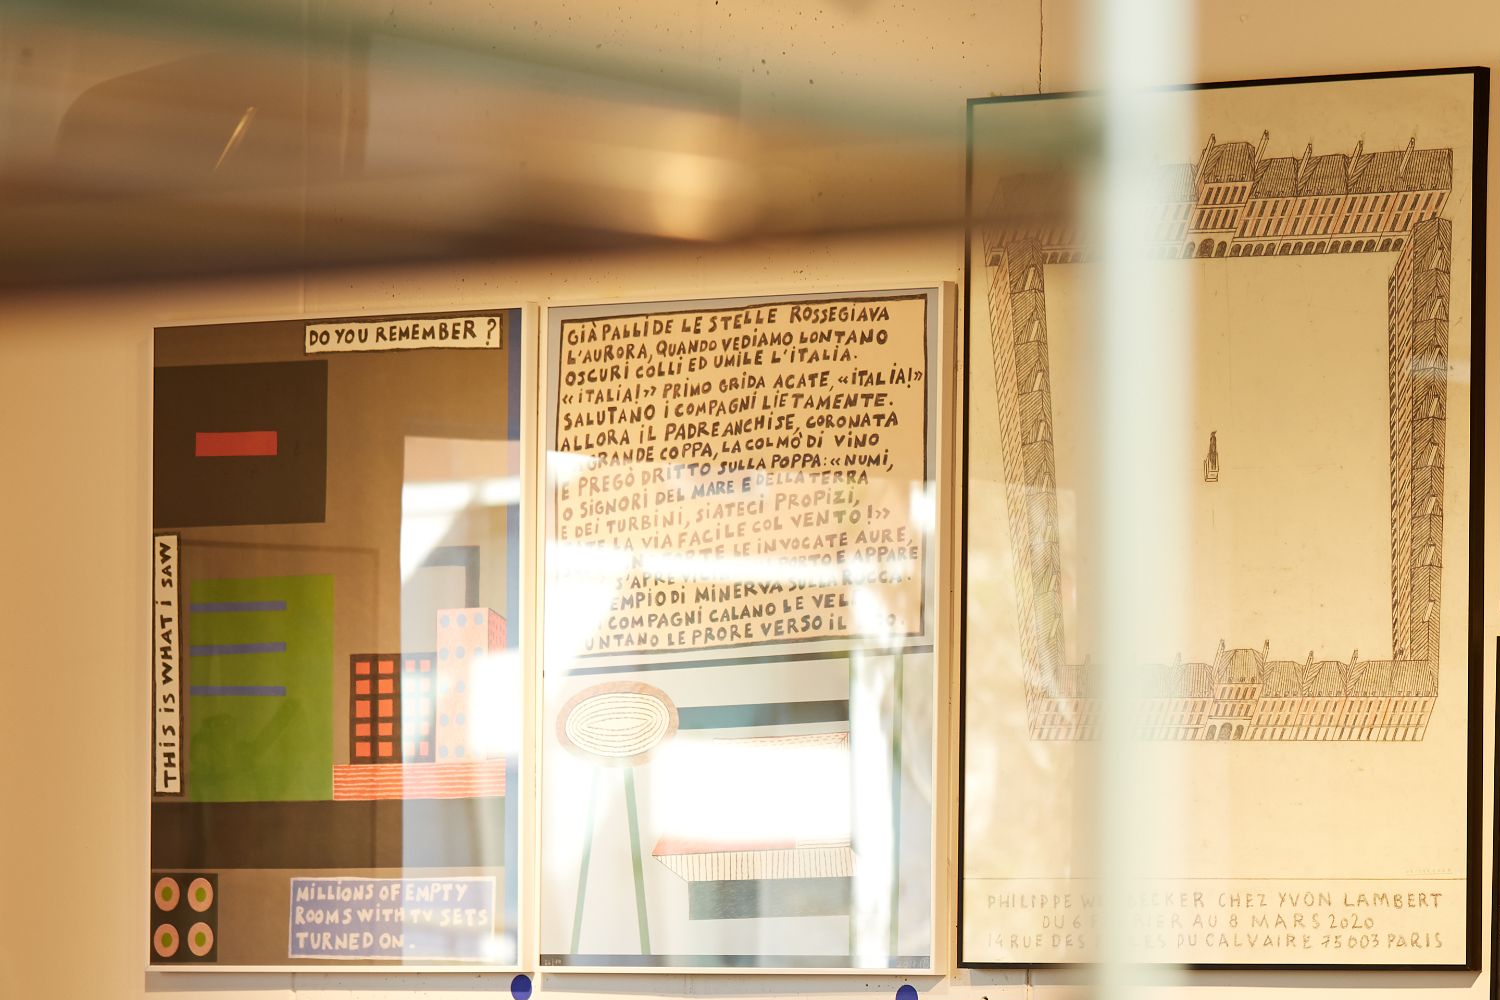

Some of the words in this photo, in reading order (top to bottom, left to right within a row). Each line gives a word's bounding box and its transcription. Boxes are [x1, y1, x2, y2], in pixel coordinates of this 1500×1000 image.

[310, 330, 330, 346] DO
[335, 327, 368, 344] YOU
[375, 320, 477, 343] REMEMBER
[602, 316, 673, 341] PALLIDE
[682, 316, 702, 334] LE
[708, 308, 777, 333] STELLE
[790, 304, 889, 324] ROSSEGIAVA
[656, 340, 717, 357] QUANDO
[722, 328, 793, 351] VEDIAMO
[800, 329, 888, 345] LONTANO
[565, 361, 629, 386] OSCURI
[635, 357, 682, 379] COLLI
[688, 357, 708, 372] ED
[714, 350, 763, 369] UMILE
[662, 378, 712, 399] PRIMO
[719, 372, 765, 393] GRIDA
[564, 404, 656, 431] SALUTANO
[674, 391, 757, 417] COMPAGNI
[561, 429, 630, 452] ALLORA
[639, 424, 656, 444] IL
[664, 421, 720, 442] PADRE
[806, 411, 898, 429] CORONATA
[722, 440, 741, 454] LA
[806, 431, 824, 448] DI
[834, 431, 880, 448] VINO
[159, 542, 174, 588] SAW
[608, 606, 702, 630] COMPAGNI
[709, 602, 776, 623] CALANO
[761, 614, 823, 637] VERSO
[160, 615, 174, 685] WHAT
[159, 693, 175, 713] IS
[159, 724, 177, 788] THIS
[296, 881, 374, 902] MILLIONS
[379, 883, 401, 901] OF
[405, 883, 468, 902] EMPTY
[1218, 892, 1267, 909] CHEZ
[1278, 891, 1332, 908] YVON
[1344, 892, 1442, 909] LAMBERT
[295, 905, 352, 925] ROOMS
[357, 903, 404, 923] WITH
[410, 908, 432, 924] TV
[440, 908, 488, 928] SETS
[1251, 913, 1320, 929] MARS
[1328, 913, 1374, 929] 2020
[296, 932, 374, 951] TURNED
[1387, 932, 1443, 949] PARIS
